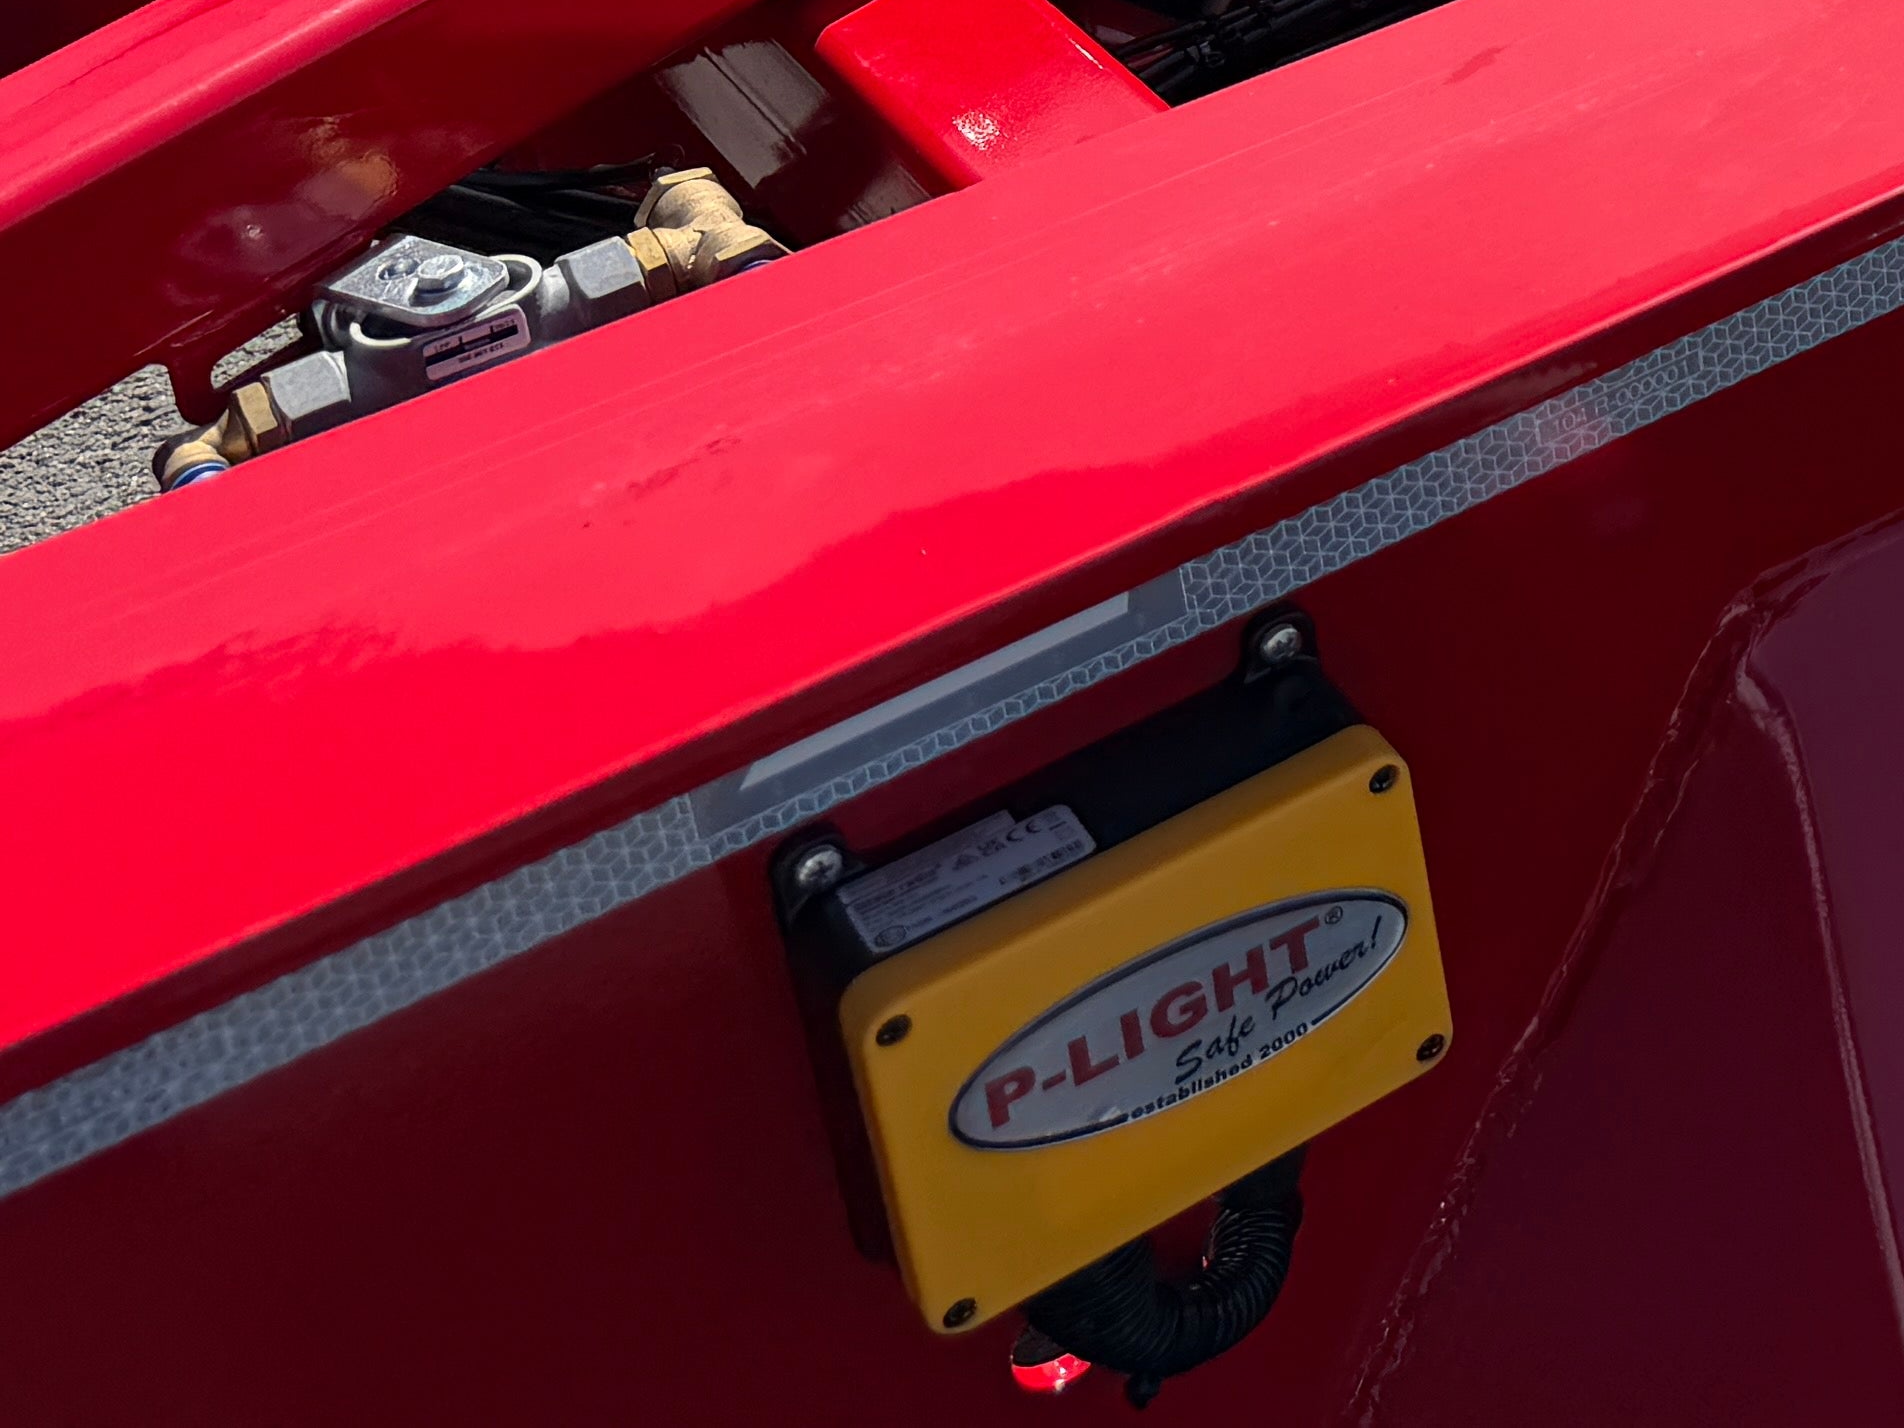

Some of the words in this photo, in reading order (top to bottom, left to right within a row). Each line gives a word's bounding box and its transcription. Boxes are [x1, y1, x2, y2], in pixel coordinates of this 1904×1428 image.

[985, 916, 1321, 1130] P-LIGHT
[1129, 1053, 1254, 1121] established
[1259, 1021, 1310, 1062] 2000
[1174, 1014, 1256, 1086] Safe
[1264, 914, 1384, 1021] Power!
